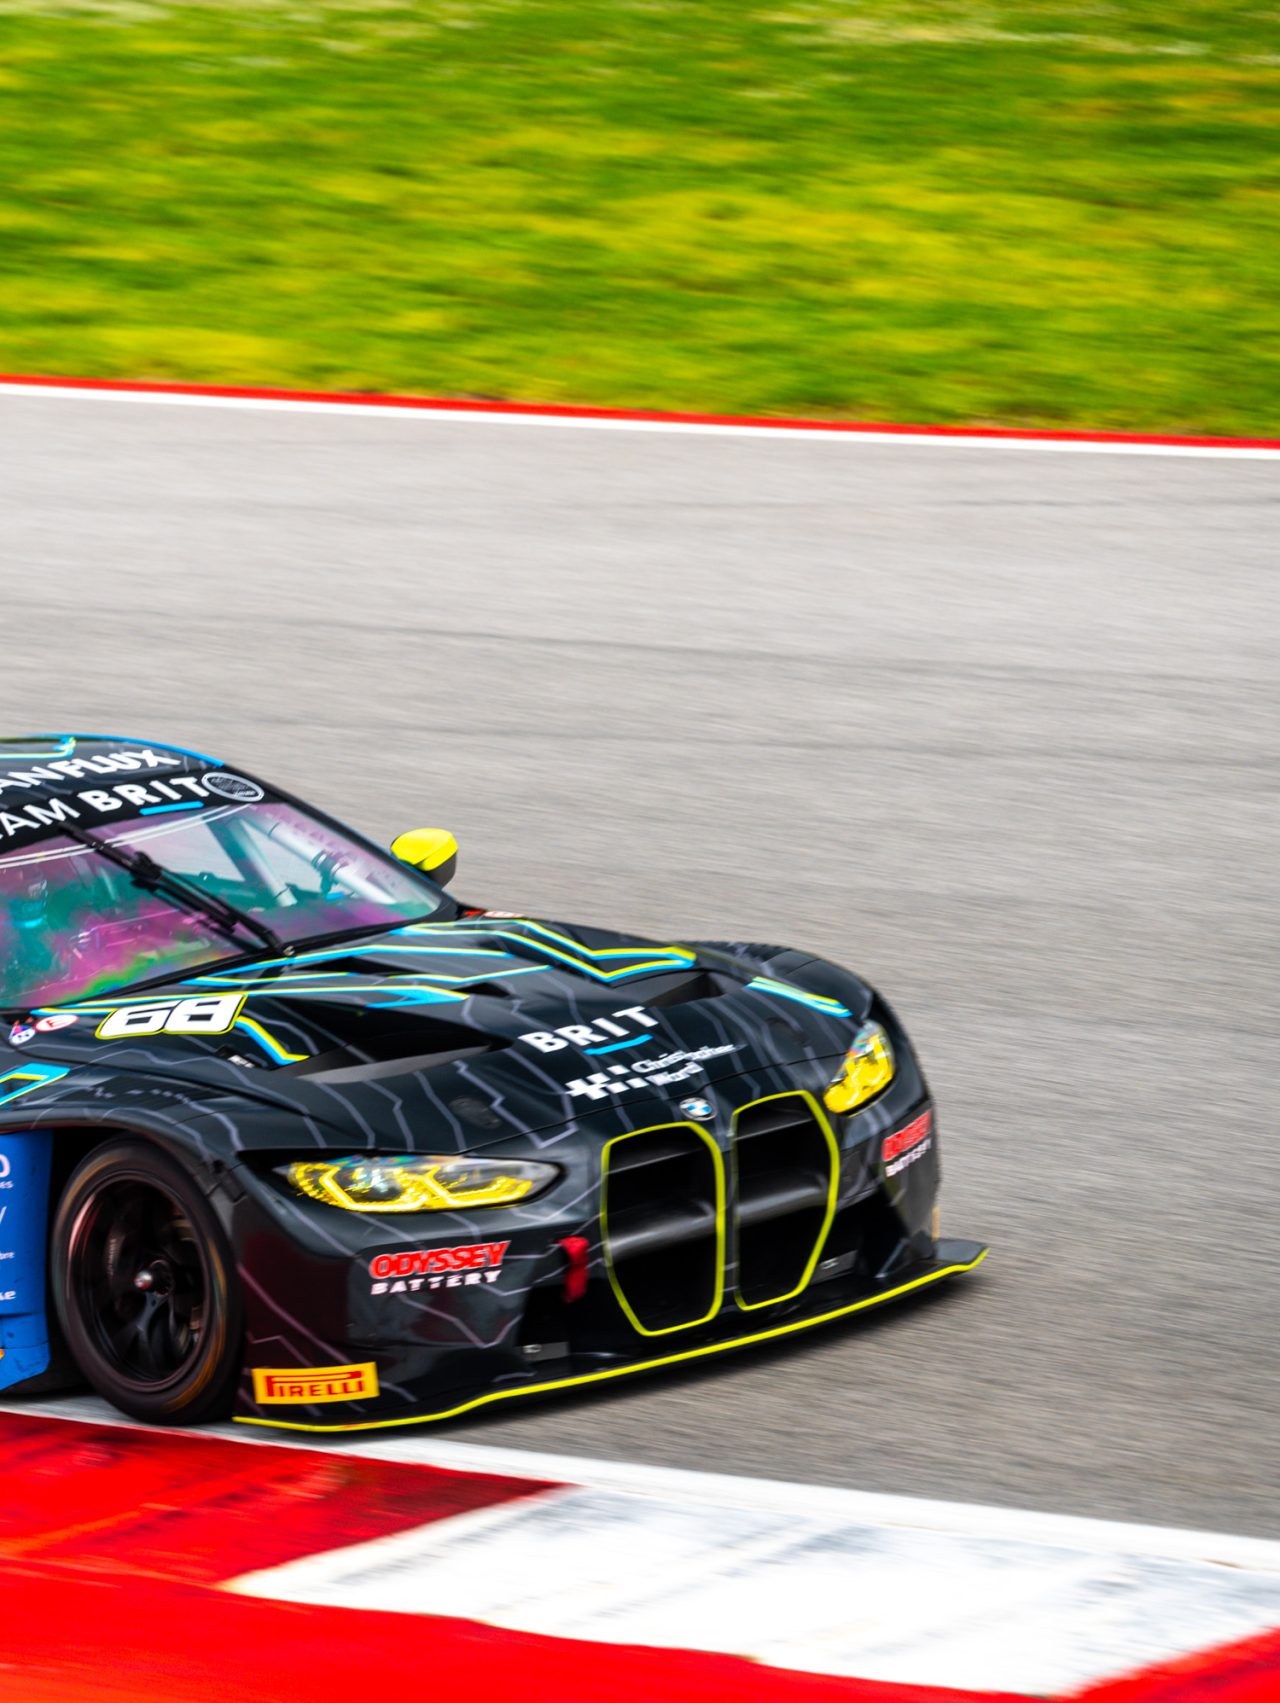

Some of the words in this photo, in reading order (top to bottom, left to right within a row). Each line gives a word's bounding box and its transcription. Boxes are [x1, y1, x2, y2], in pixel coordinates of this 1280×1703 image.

[77, 775, 211, 812] BRIT
[101, 997, 241, 1036] 68
[518, 1005, 659, 1053] BRIT
[369, 1240, 512, 1279] ODYSSEY
[371, 1270, 502, 1295] BATTERY
[264, 1370, 365, 1398] PIRELLI
